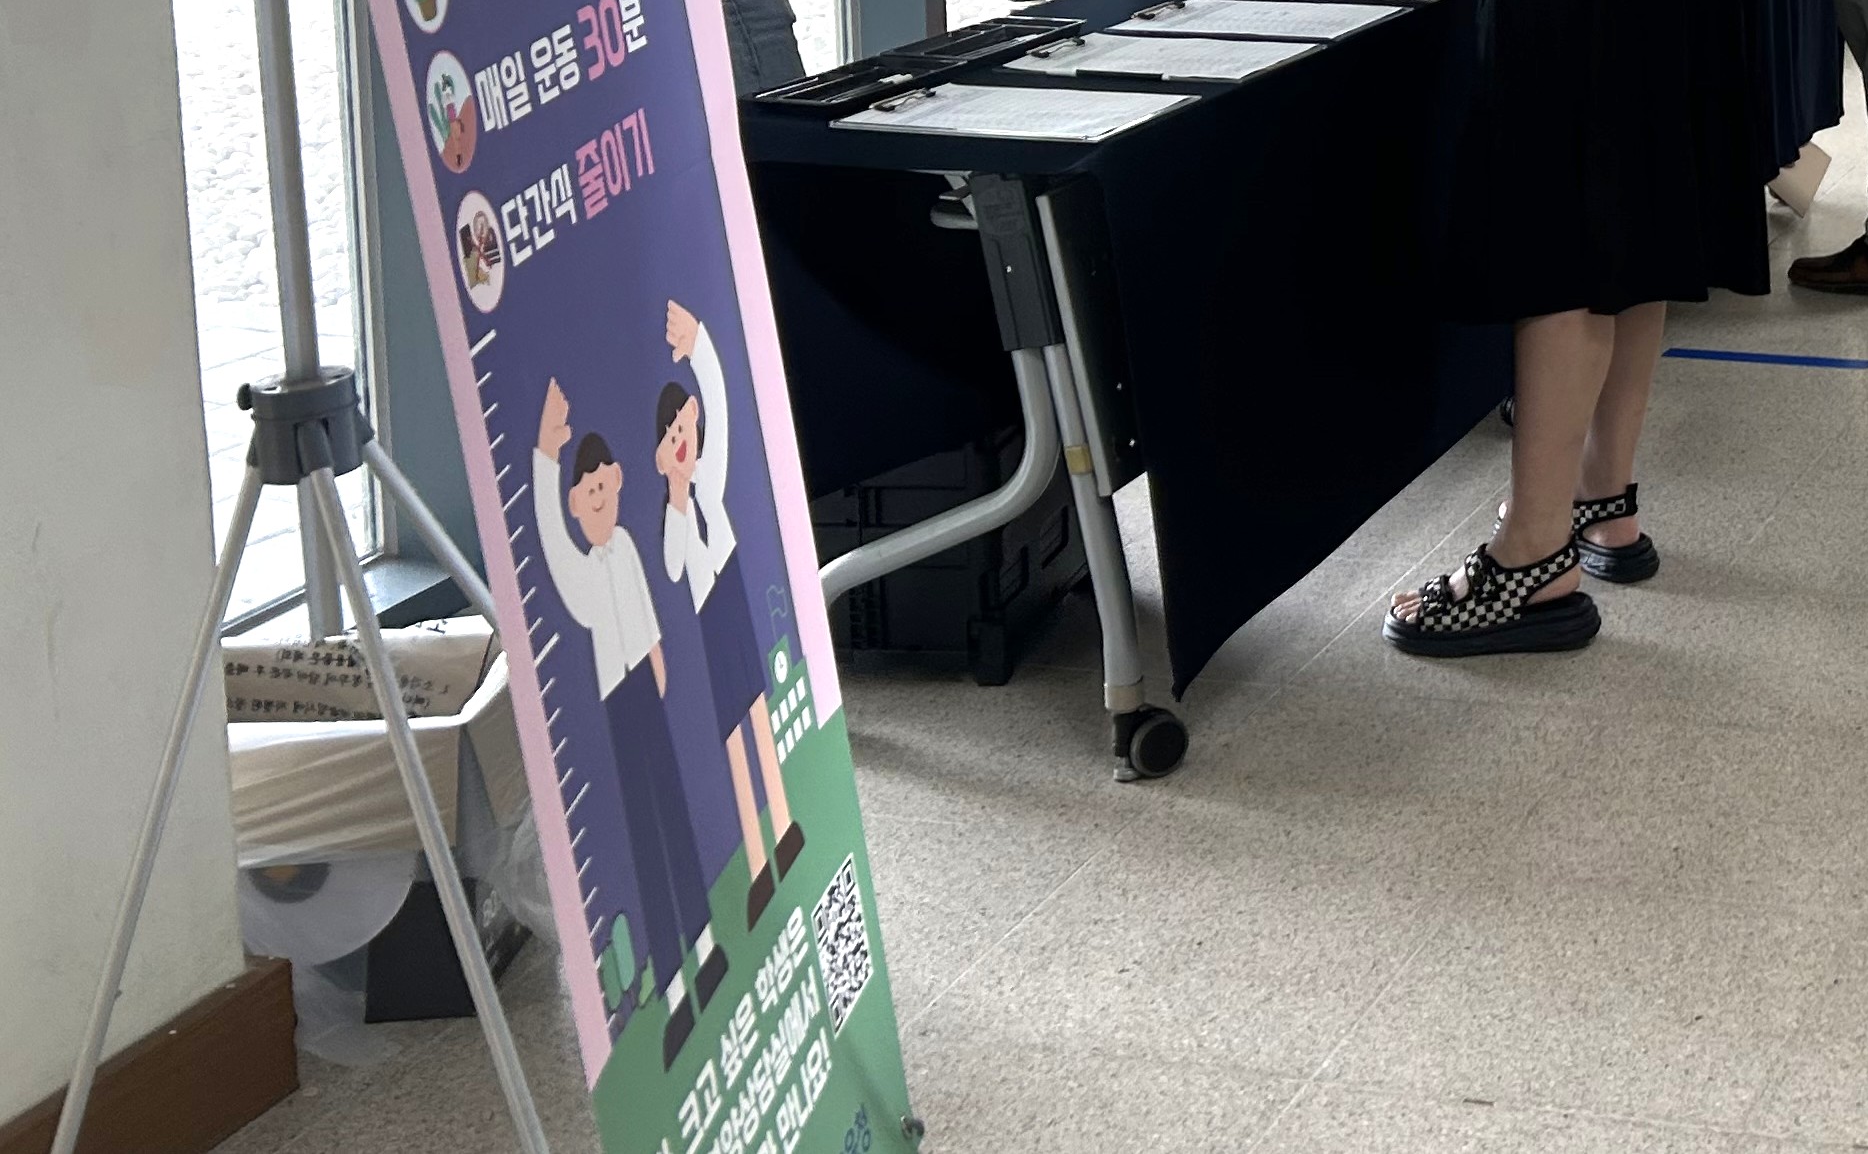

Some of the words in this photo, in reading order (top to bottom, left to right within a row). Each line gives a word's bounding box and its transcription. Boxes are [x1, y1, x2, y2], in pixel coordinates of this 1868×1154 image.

[474, 51, 532, 132] 매일
[529, 24, 582, 104] 운동
[574, 107, 655, 219] 줄이기
[707, 964, 821, 1154] 양상담실에서
[720, 992, 759, 1091] 싶은
[754, 906, 809, 1014] 학생은
